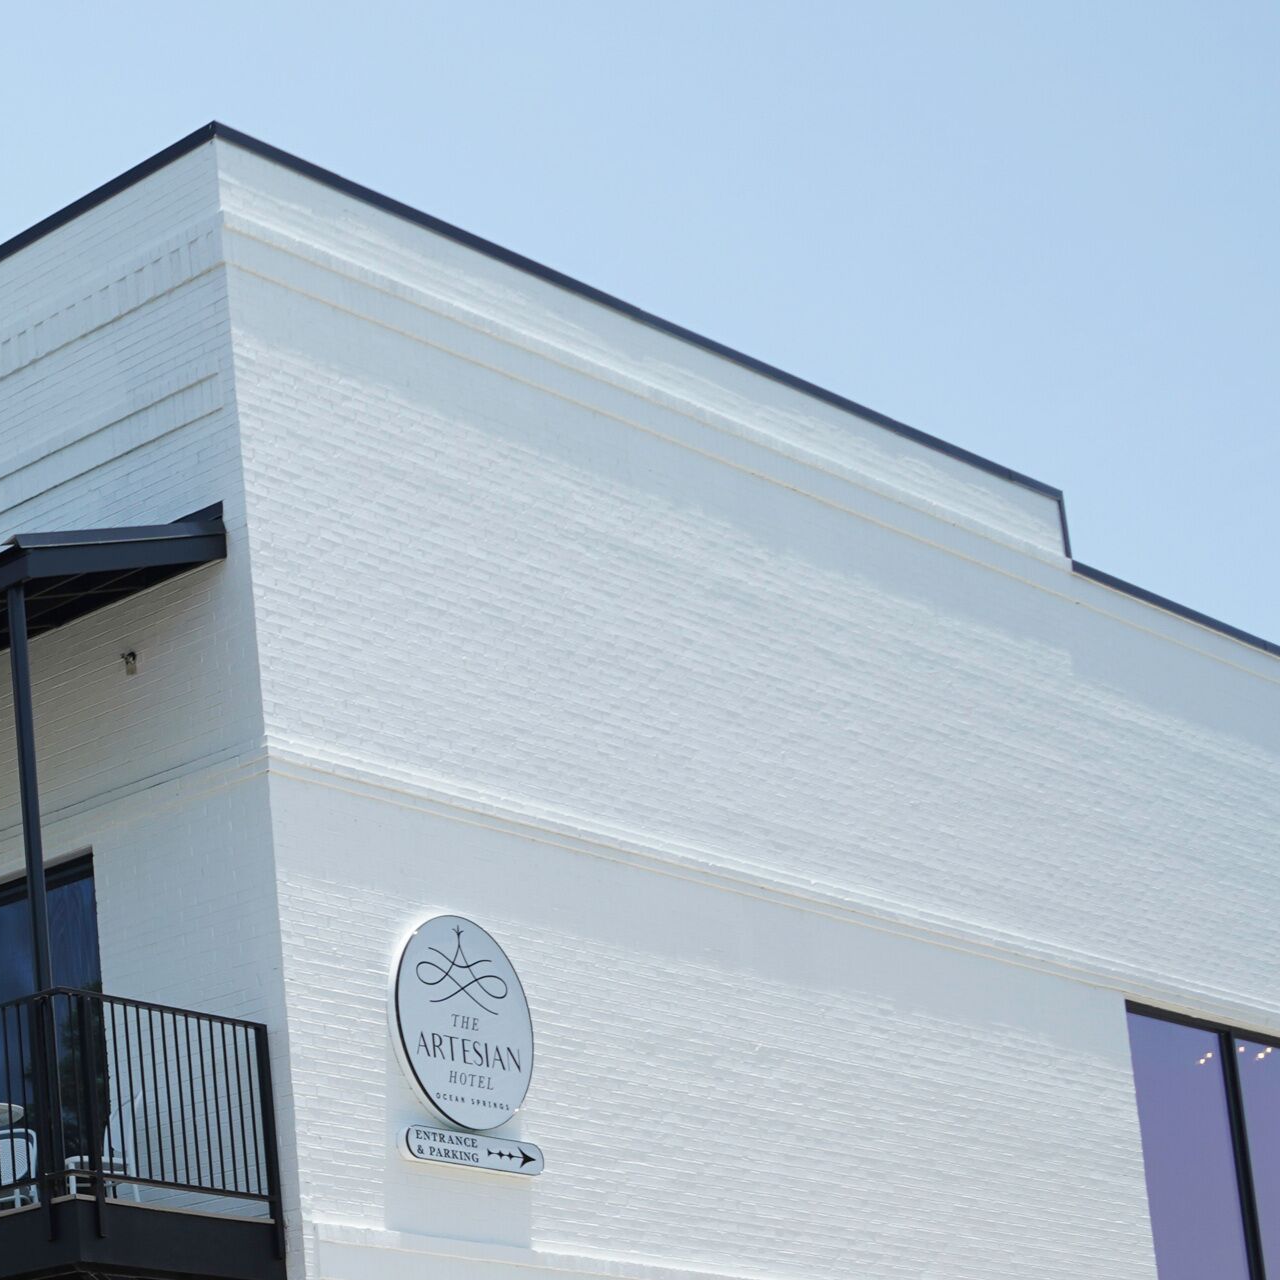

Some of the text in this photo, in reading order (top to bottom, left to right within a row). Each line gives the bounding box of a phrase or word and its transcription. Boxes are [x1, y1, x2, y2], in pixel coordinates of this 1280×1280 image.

[450, 1013, 480, 1032] THE
[416, 1031, 522, 1073] ARTESIAN
[448, 1070, 494, 1091] HOTEL
[435, 1092, 511, 1111] OCEAN SPRINGS
[415, 1129, 479, 1149] ENTRANCE
[416, 1144, 480, 1164] & PARKING
